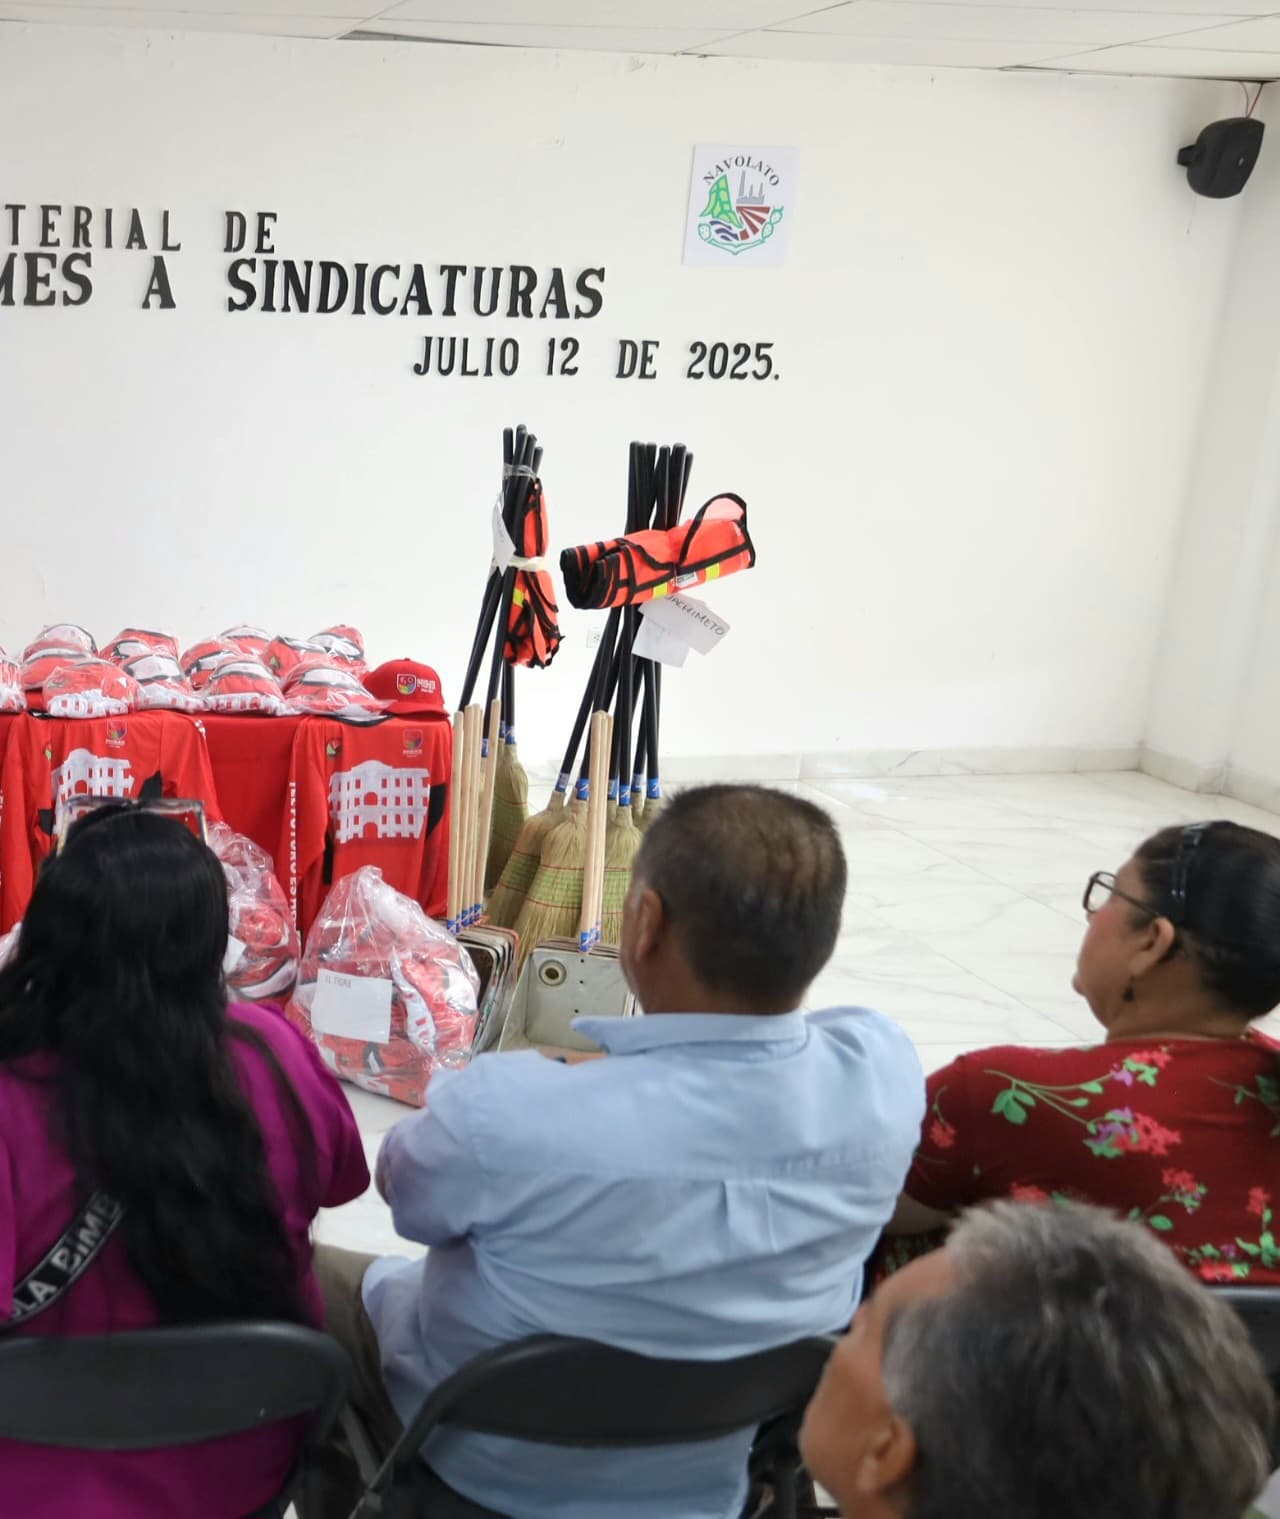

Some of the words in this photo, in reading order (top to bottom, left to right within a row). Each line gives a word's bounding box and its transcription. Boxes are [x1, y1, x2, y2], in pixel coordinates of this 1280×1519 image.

[703, 155, 780, 186] NAVOLATO
[223, 211, 277, 254] DE
[141, 255, 176, 309] A
[227, 257, 605, 319] SINDICATURAS
[413, 336, 519, 377] JULIO
[547, 337, 579, 376] 12
[615, 339, 660, 379] DE
[686, 341, 780, 380] 2025.
